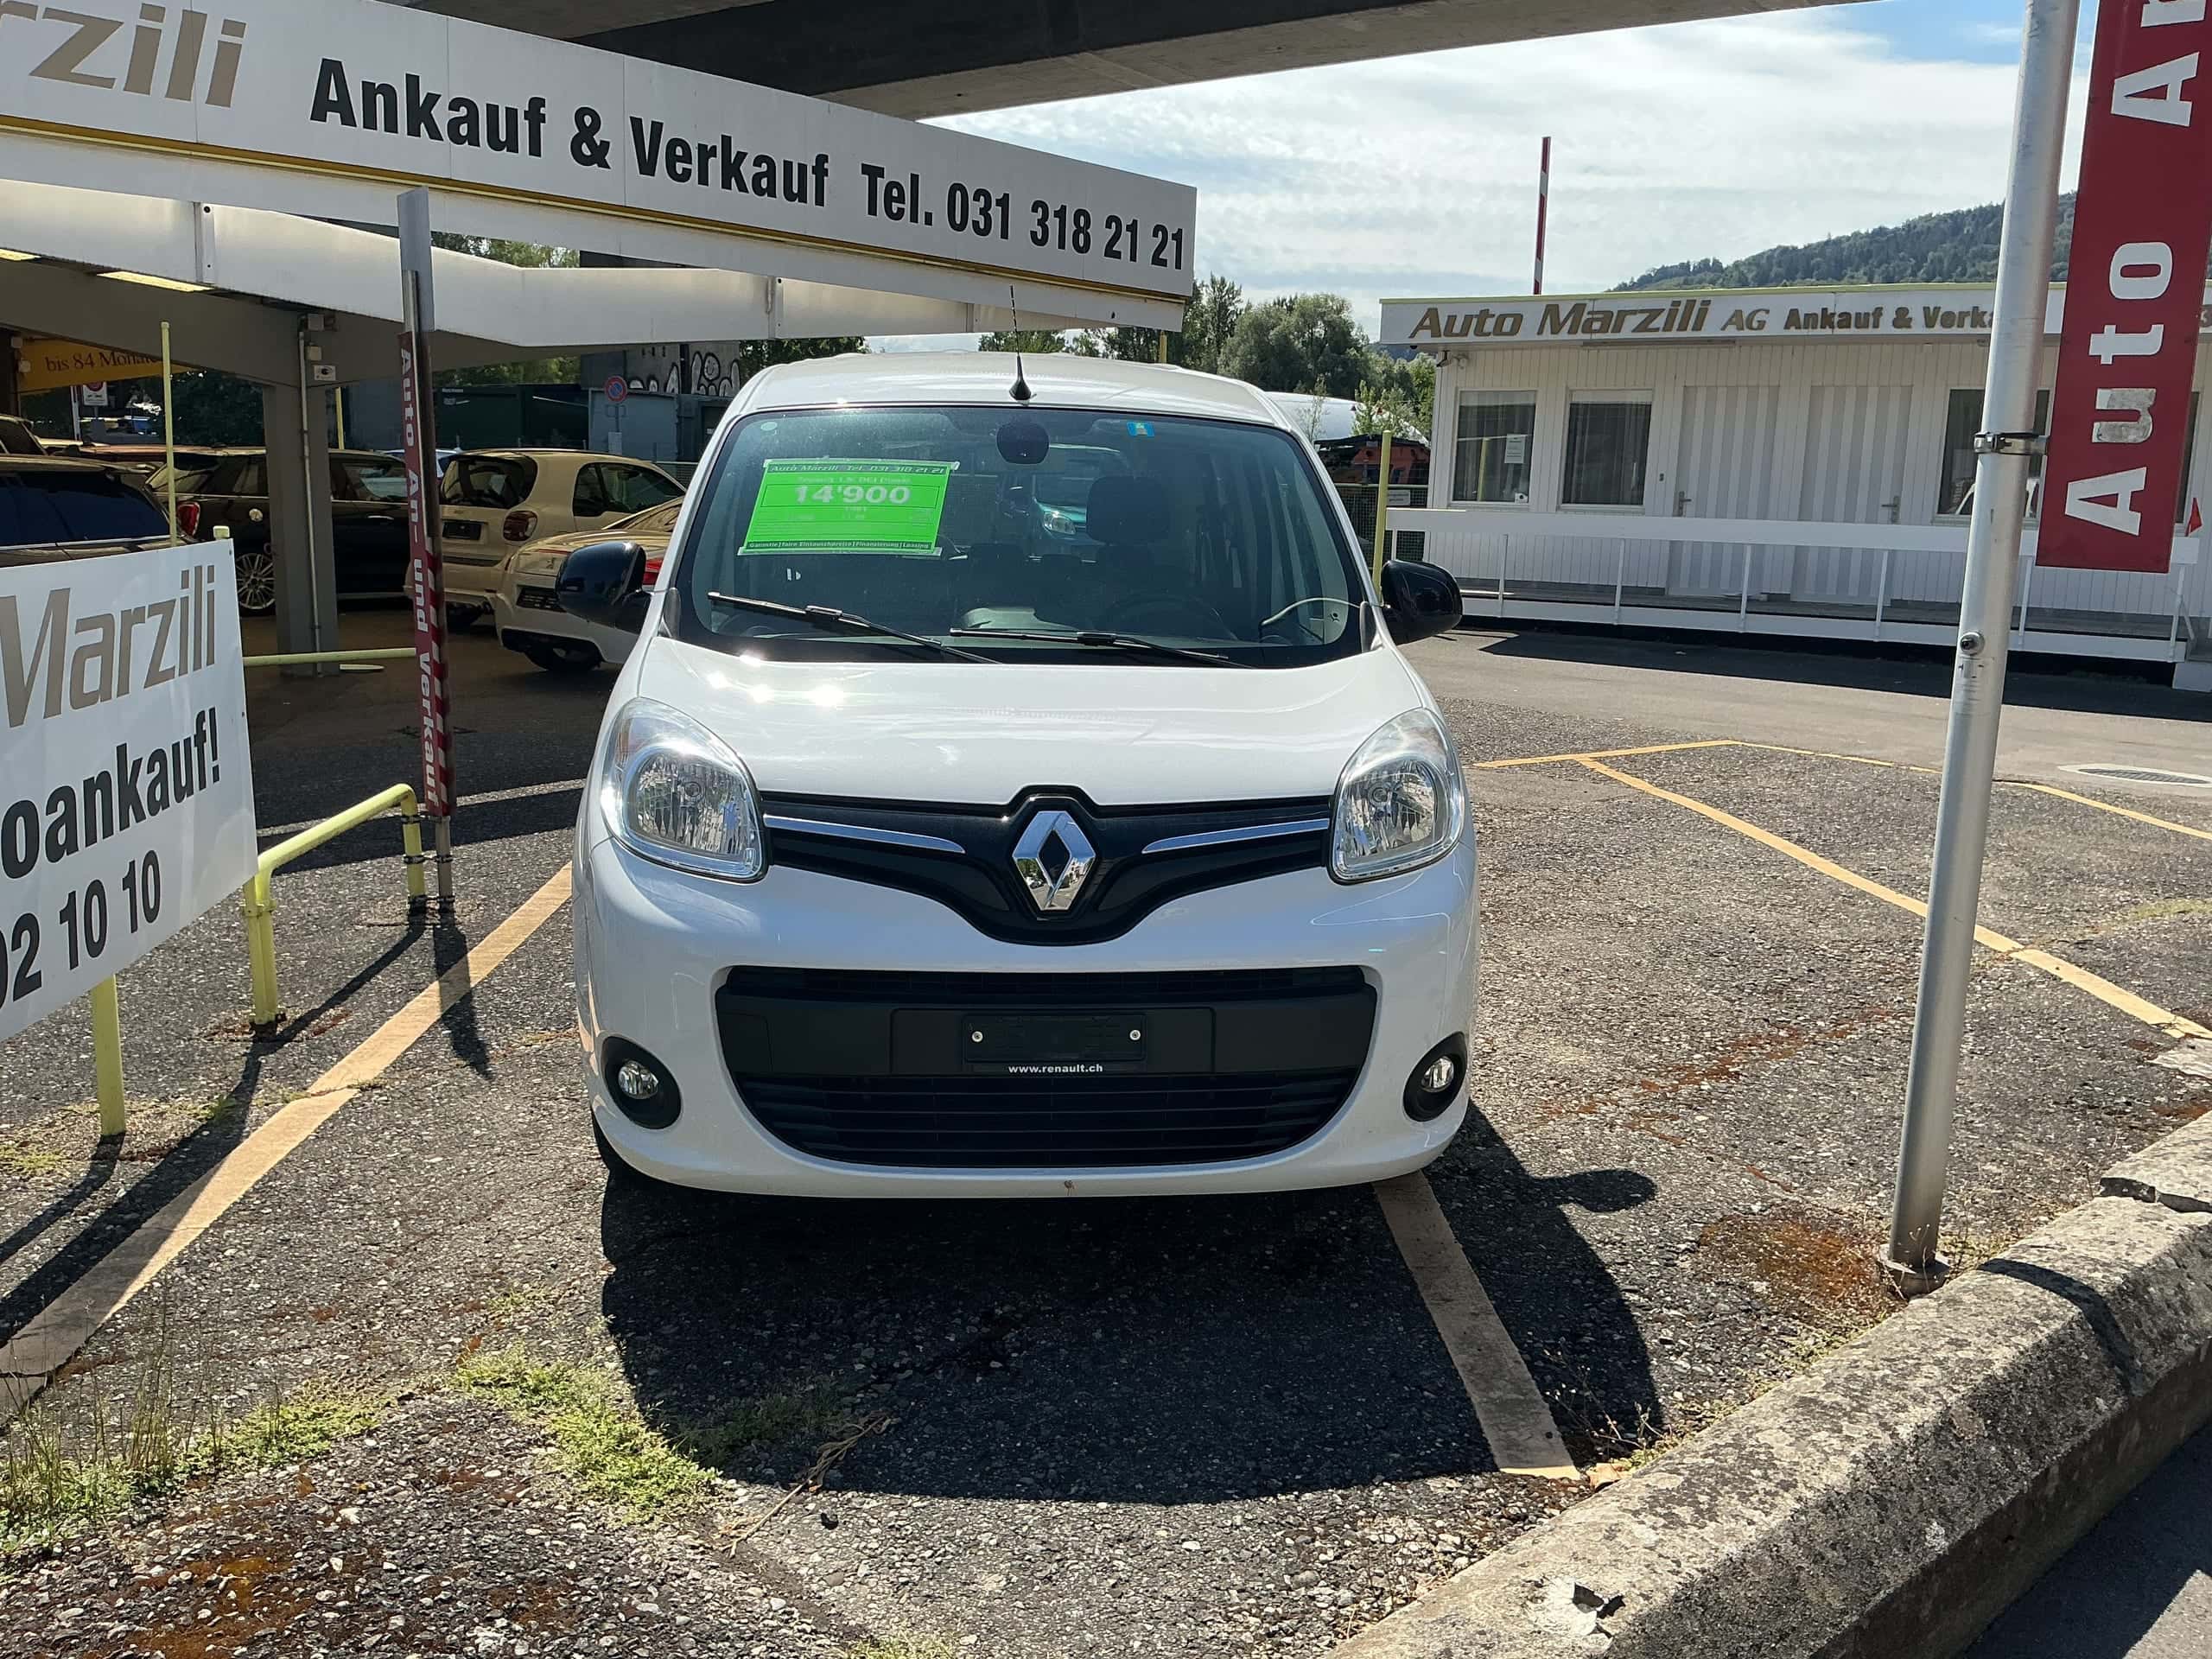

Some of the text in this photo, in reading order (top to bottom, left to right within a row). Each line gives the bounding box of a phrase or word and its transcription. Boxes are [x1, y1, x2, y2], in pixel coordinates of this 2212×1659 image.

[309, 57, 547, 158] Ankauf
[569, 105, 611, 170] &
[629, 116, 829, 207] Verkauf
[861, 162, 932, 226] Tel.
[947, 182, 1010, 240] 031
[1029, 200, 1091, 256] 318
[1103, 214, 1138, 262] 21
[1150, 223, 1184, 270] 21
[45, 356, 69, 372] bis
[73, 352, 95, 370] 84
[1408, 307, 1523, 339] Auto
[1536, 299, 1712, 336] Marzili
[1720, 308, 1770, 331] AG
[1783, 307, 1884, 330] Ankauf
[1891, 306, 1912, 329] &
[2064, 240, 2174, 536] Auto
[795, 485, 911, 504] 14'900
[413, 558, 429, 632] und
[0, 565, 215, 728] Marzili
[419, 652, 440, 809] Verkauf
[60, 880, 107, 970] 10
[123, 850, 161, 933] 10
[1008, 1064, 1103, 1073] www.renault.ch
